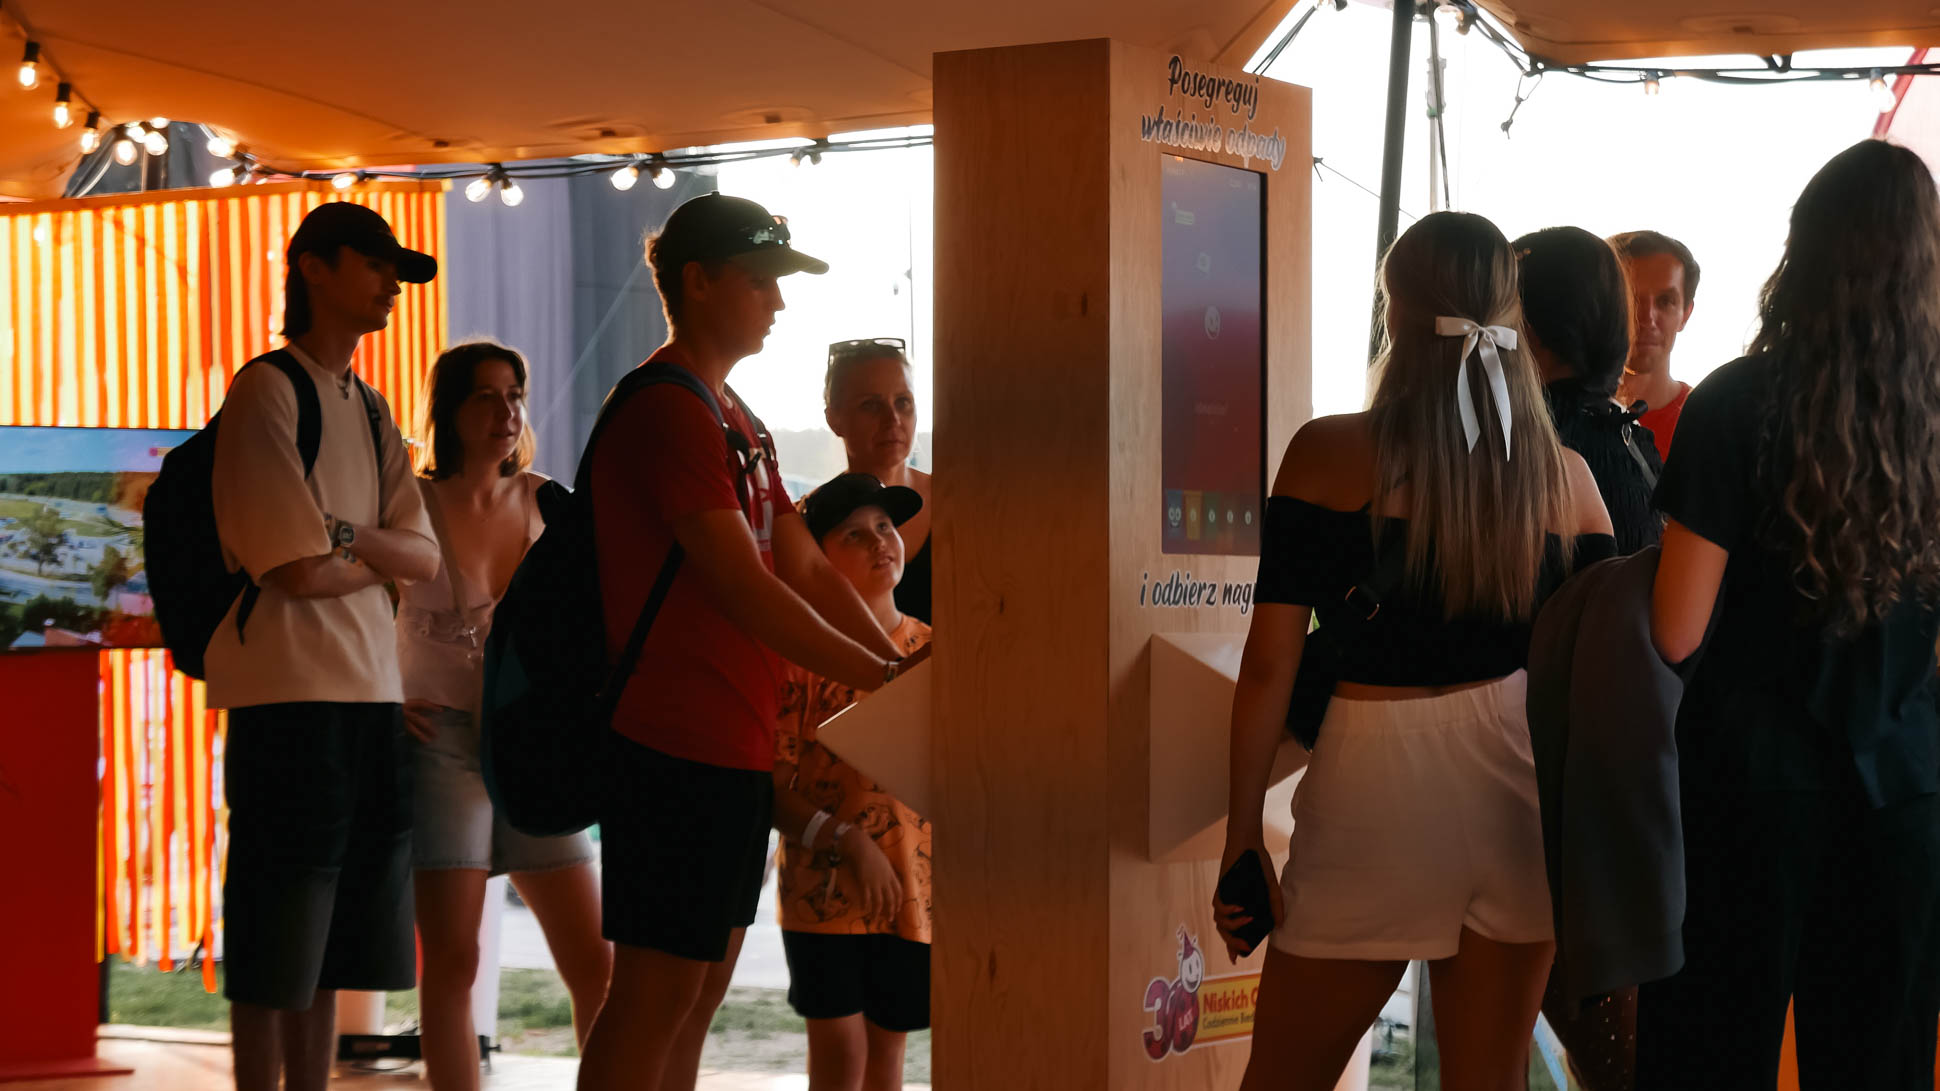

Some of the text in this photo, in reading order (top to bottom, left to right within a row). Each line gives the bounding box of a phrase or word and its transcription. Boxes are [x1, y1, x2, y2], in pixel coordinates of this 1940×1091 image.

[1168, 55, 1259, 121] Posegreguj
[1141, 105, 1286, 170] właściwie odpady
[1140, 572, 1148, 606] i
[1152, 571, 1217, 606] odbierz
[1143, 977, 1200, 1060] 30
[1178, 1010, 1194, 1031] LAT
[1203, 988, 1249, 1014] Niskich
